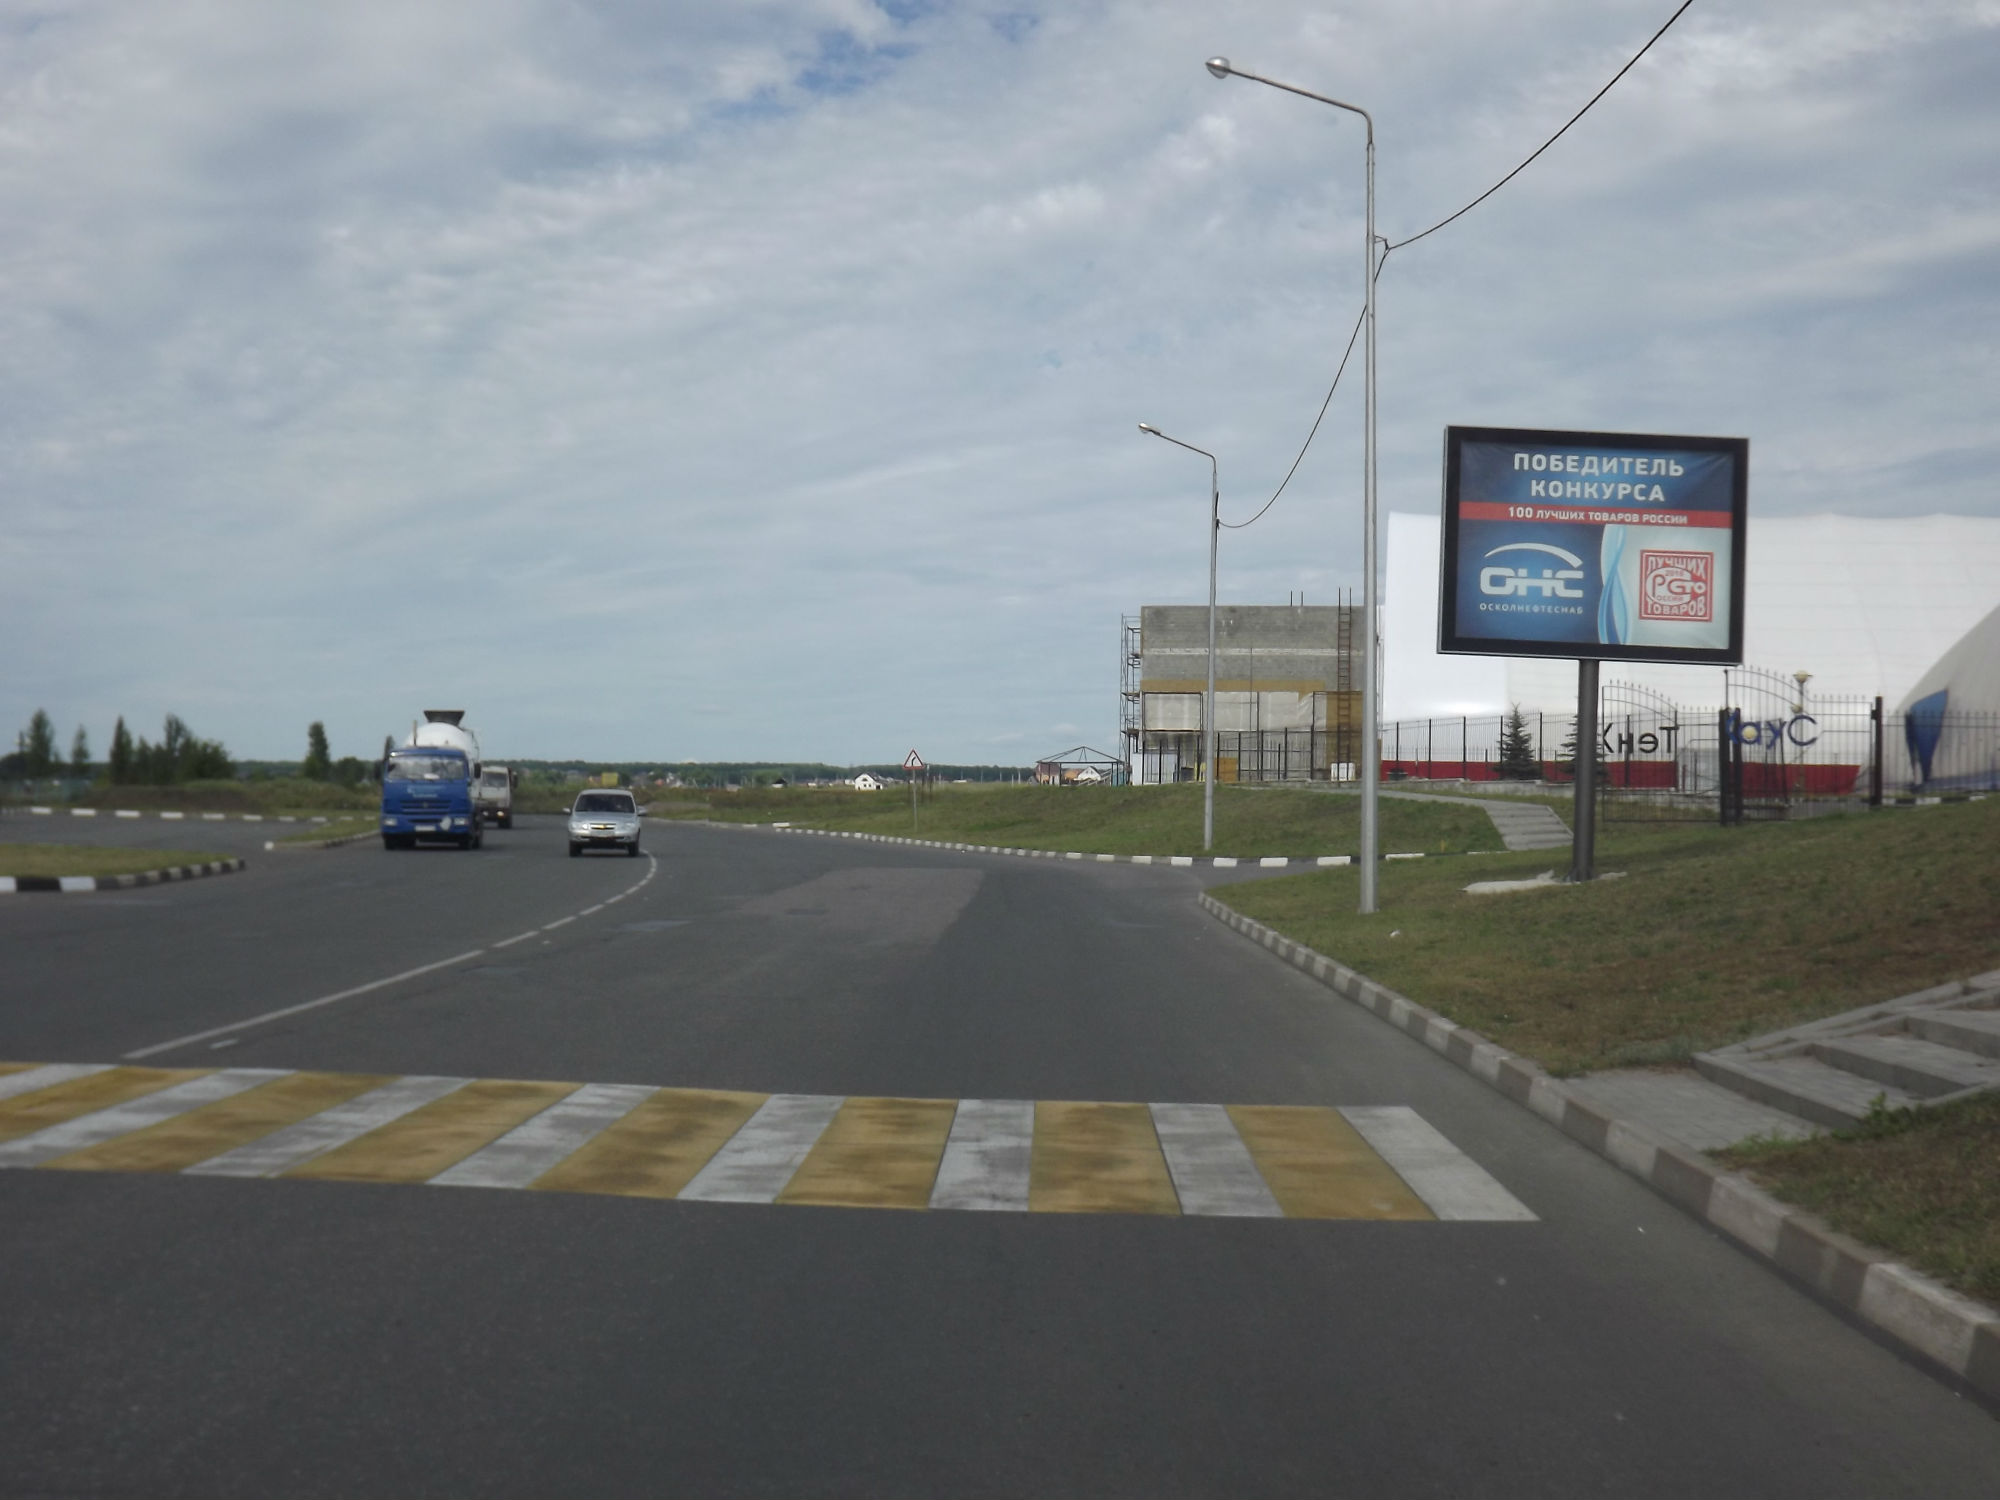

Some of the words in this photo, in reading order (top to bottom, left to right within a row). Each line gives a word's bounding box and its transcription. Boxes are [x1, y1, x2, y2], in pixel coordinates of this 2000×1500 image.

[1513, 453, 1685, 477] ПОБЕДИТЕЛЬ
[1530, 479, 1666, 502] КОНКУРСА
[1508, 506, 1533, 519] 100
[1536, 509, 1585, 521] ЛУЧШИХ
[1588, 511, 1640, 523] ТОВАРОВ
[1642, 514, 1688, 525] РОССИИ
[1647, 555, 1706, 580] ЛУЧШИХ
[1480, 602, 1583, 615] ОСКОЛНЕФТЕСНАБ
[1646, 595, 1706, 617] ТОВАРОВ
